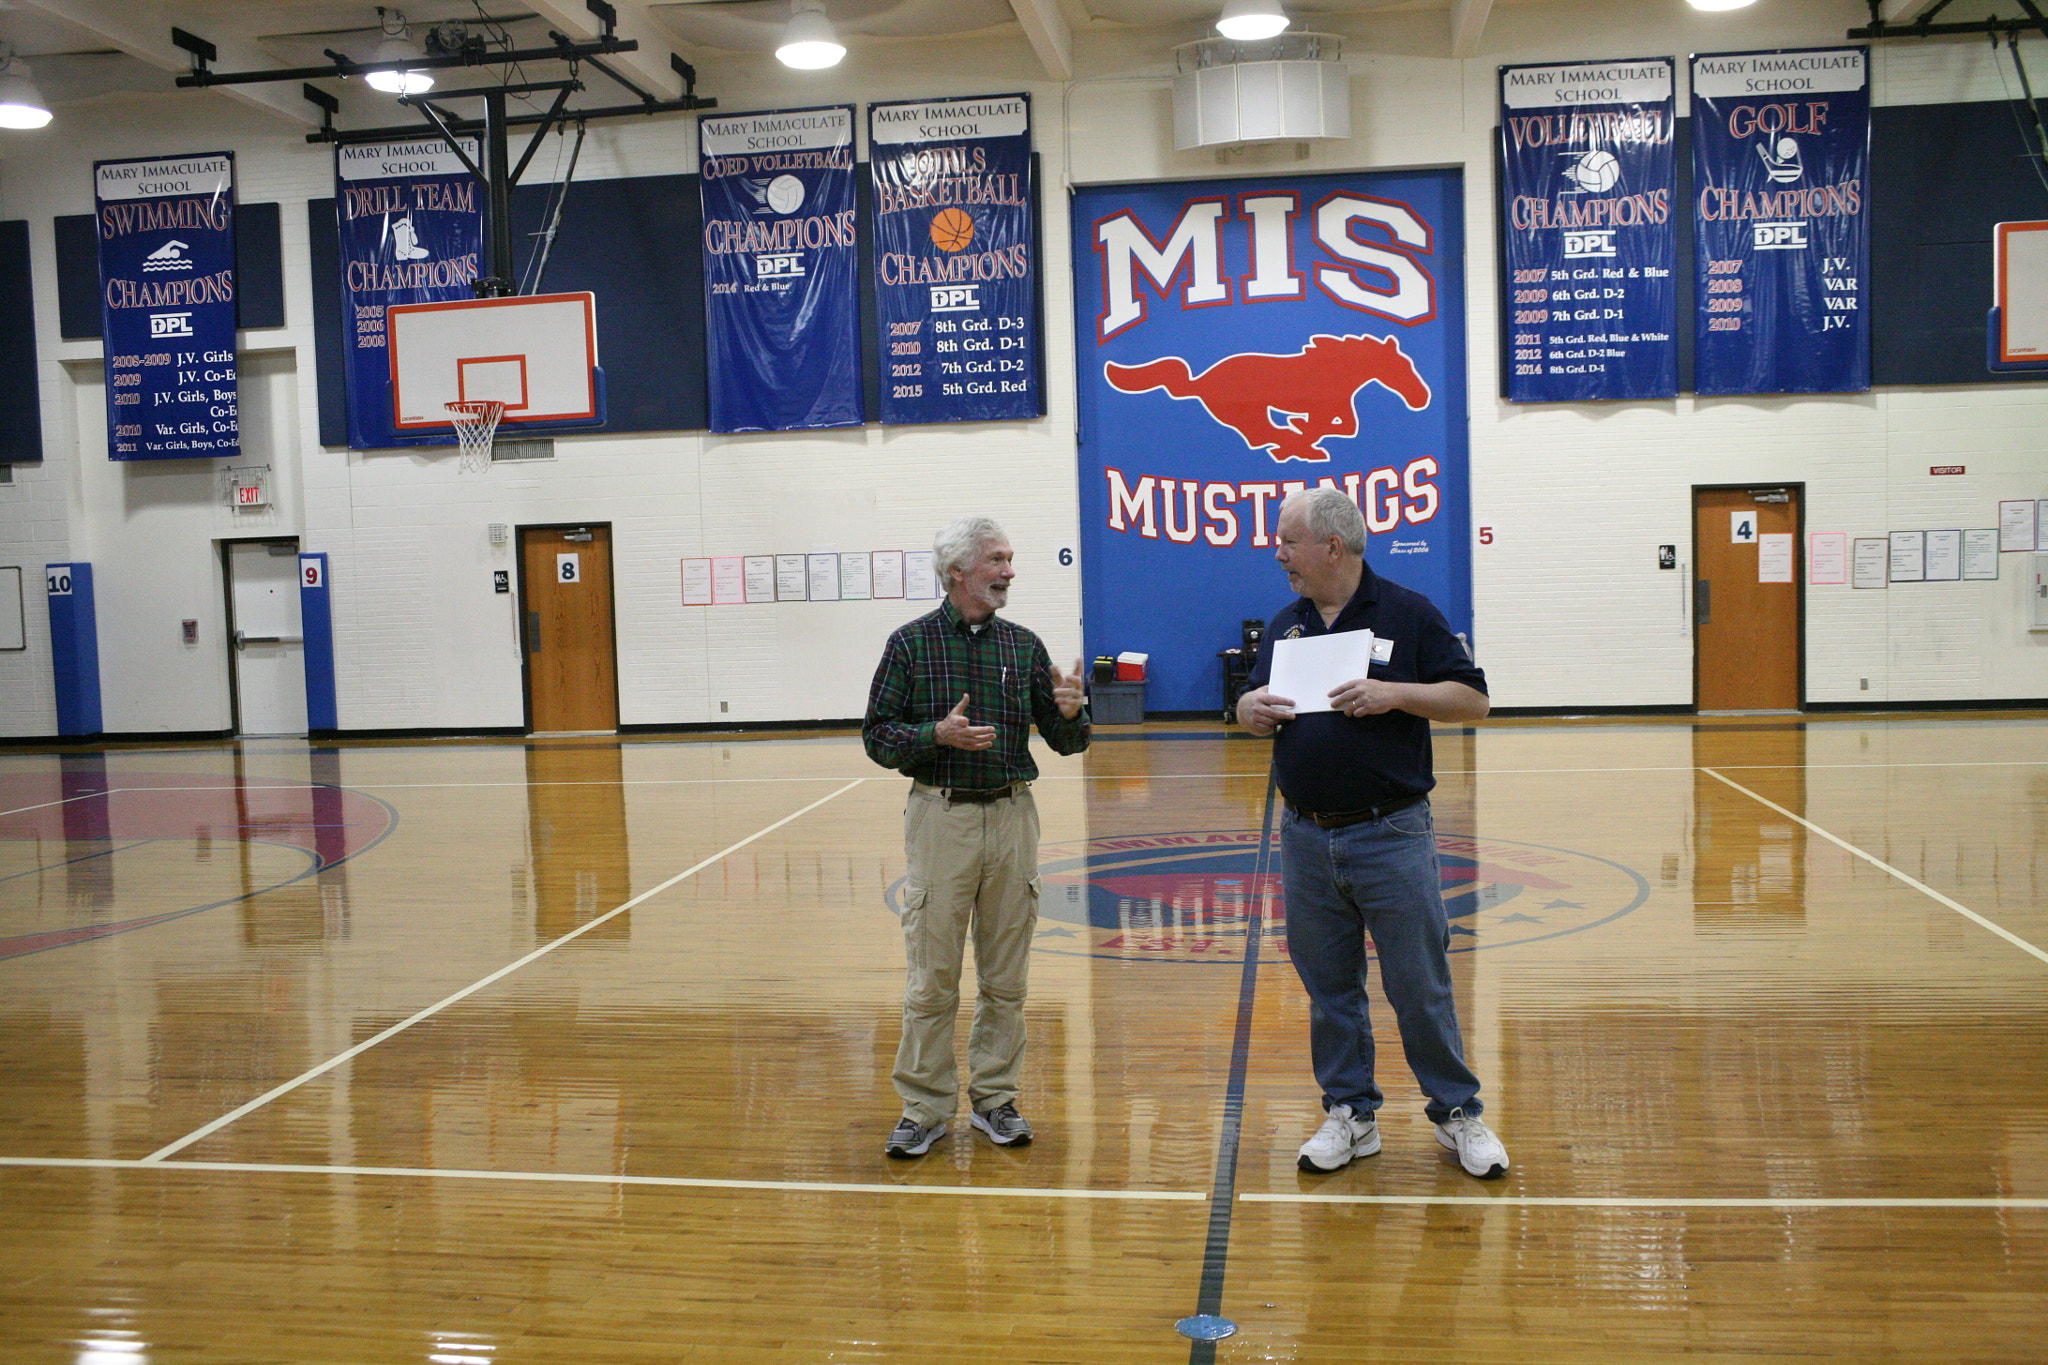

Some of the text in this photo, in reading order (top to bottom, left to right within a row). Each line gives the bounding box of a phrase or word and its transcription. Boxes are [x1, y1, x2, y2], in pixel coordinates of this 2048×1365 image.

[1700, 56, 1859, 75] MARY IMMACULATE
[1510, 66, 1666, 86] MARY IMMACULATE
[1746, 78, 1814, 92] SCHOOL
[1555, 88, 1622, 103] SCHOOL
[878, 103, 1021, 123] MARY IMMACULATE
[1729, 102, 1829, 139] GOLF
[708, 115, 846, 136] MARY IMMACULATE
[919, 123, 981, 138] SCHOOL
[1509, 110, 1670, 150] VOLLEYBALL
[344, 141, 475, 160] MARY IMMACULTE
[747, 135, 806, 150] SCHOOL
[381, 161, 437, 175] SCHOOL
[703, 149, 854, 180] COED VOLLEYBALL
[915, 146, 987, 176] GIRLS
[101, 161, 227, 181] MARY IMMACULATE
[138, 181, 191, 195] SCHOOL
[879, 173, 1026, 215] BASKETBALL
[344, 182, 476, 220] DRILL TEAM
[1511, 188, 1668, 230] CHAMPIONS
[1701, 179, 1861, 221] CHAMPIONS
[103, 198, 228, 239] SWIMMING
[706, 210, 856, 254] CHAMPIONS
[1754, 227, 1807, 245] DPL
[1564, 235, 1616, 253] DPL
[348, 253, 478, 292] CHAMPIONS
[757, 257, 805, 275] DPL
[881, 244, 1027, 285] CHAMPIONS
[1093, 189, 1437, 346] MIS
[1708, 258, 1850, 274] 2007 J.V.
[1513, 267, 1670, 283] 2007 5th Grd. Red & Blue
[107, 270, 233, 309] CHAMPIONS
[713, 282, 790, 294] 2014 Red & Blue
[1708, 278, 1858, 293] 2008 VAR
[931, 290, 980, 308] DPL
[1514, 288, 1625, 303] 2009 6th Grd. D-2
[1708, 297, 1858, 313] 2009 VAR
[151, 317, 193, 334] DPL
[1514, 309, 1624, 324] 2009 7th Grd. D-1
[1709, 315, 1851, 332] 2010 J.V.
[357, 320, 385, 332] 2006
[890, 317, 1025, 336] 2007 8th Grd. D-3
[891, 337, 1025, 355] 2010 8th Grd. D-1
[1515, 334, 1542, 345] 2011
[1550, 336, 1564, 345] 5th
[1566, 335, 1586, 344] Grd.
[1609, 334, 1630, 342] Blue
[1631, 334, 1640, 342] &
[1641, 333, 1669, 342] White
[112, 350, 233, 368] 2008-2009 J.V. Girls
[1515, 348, 1626, 360] 2012 6th Grd. D-2 Blue
[892, 359, 1025, 377] 2012 7th Grd. D-2
[1515, 364, 1605, 375] 2014 8th Grd. D-1
[113, 373, 142, 387] 2009
[178, 371, 200, 385] J.V.
[154, 391, 175, 406] J.V.
[178, 390, 209, 404] Girls,
[892, 380, 1027, 398] 2015 5th Grd. Red
[210, 405, 237, 418] Co-E
[155, 424, 177, 435] Var.
[179, 422, 209, 435] Girls,
[116, 443, 138, 452] 2011
[146, 441, 164, 450] Var.
[165, 440, 190, 450] Girls,
[191, 440, 215, 451] Boys,
[240, 487, 259, 503] EXIT
[1480, 526, 1493, 545] 5
[1737, 520, 1752, 540] 4
[1058, 548, 1073, 566] 6
[305, 567, 318, 584] 9
[562, 562, 575, 580] 8
[48, 575, 71, 593] 10
